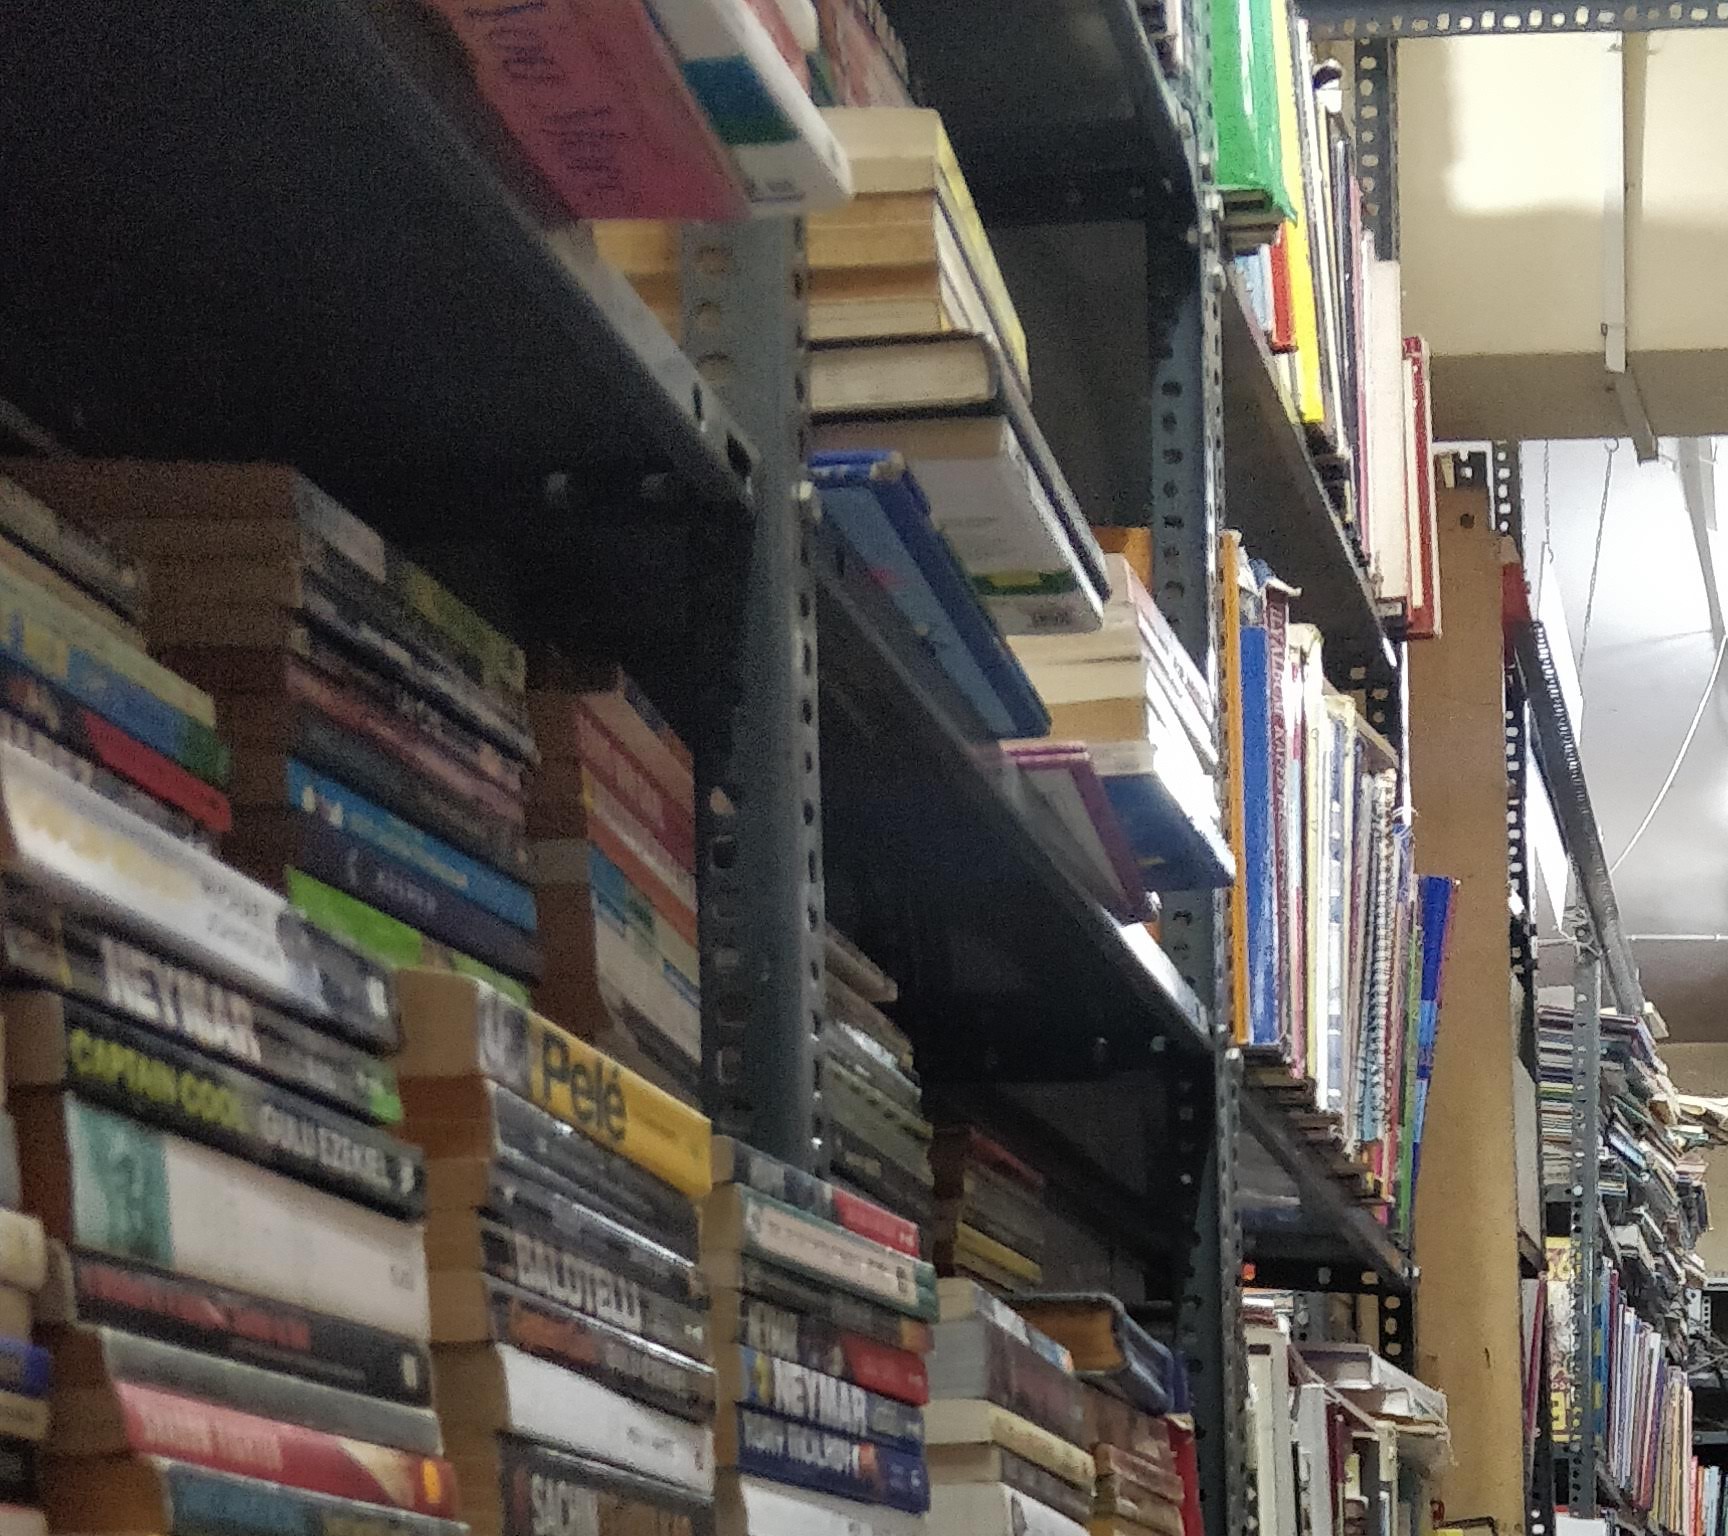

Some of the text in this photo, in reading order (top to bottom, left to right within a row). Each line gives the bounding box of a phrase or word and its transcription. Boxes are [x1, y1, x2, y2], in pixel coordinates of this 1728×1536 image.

[104, 941, 262, 1062] NEYMAR
[541, 1030, 626, 1142] Pelé
[774, 1358, 866, 1434] NEYMAR
